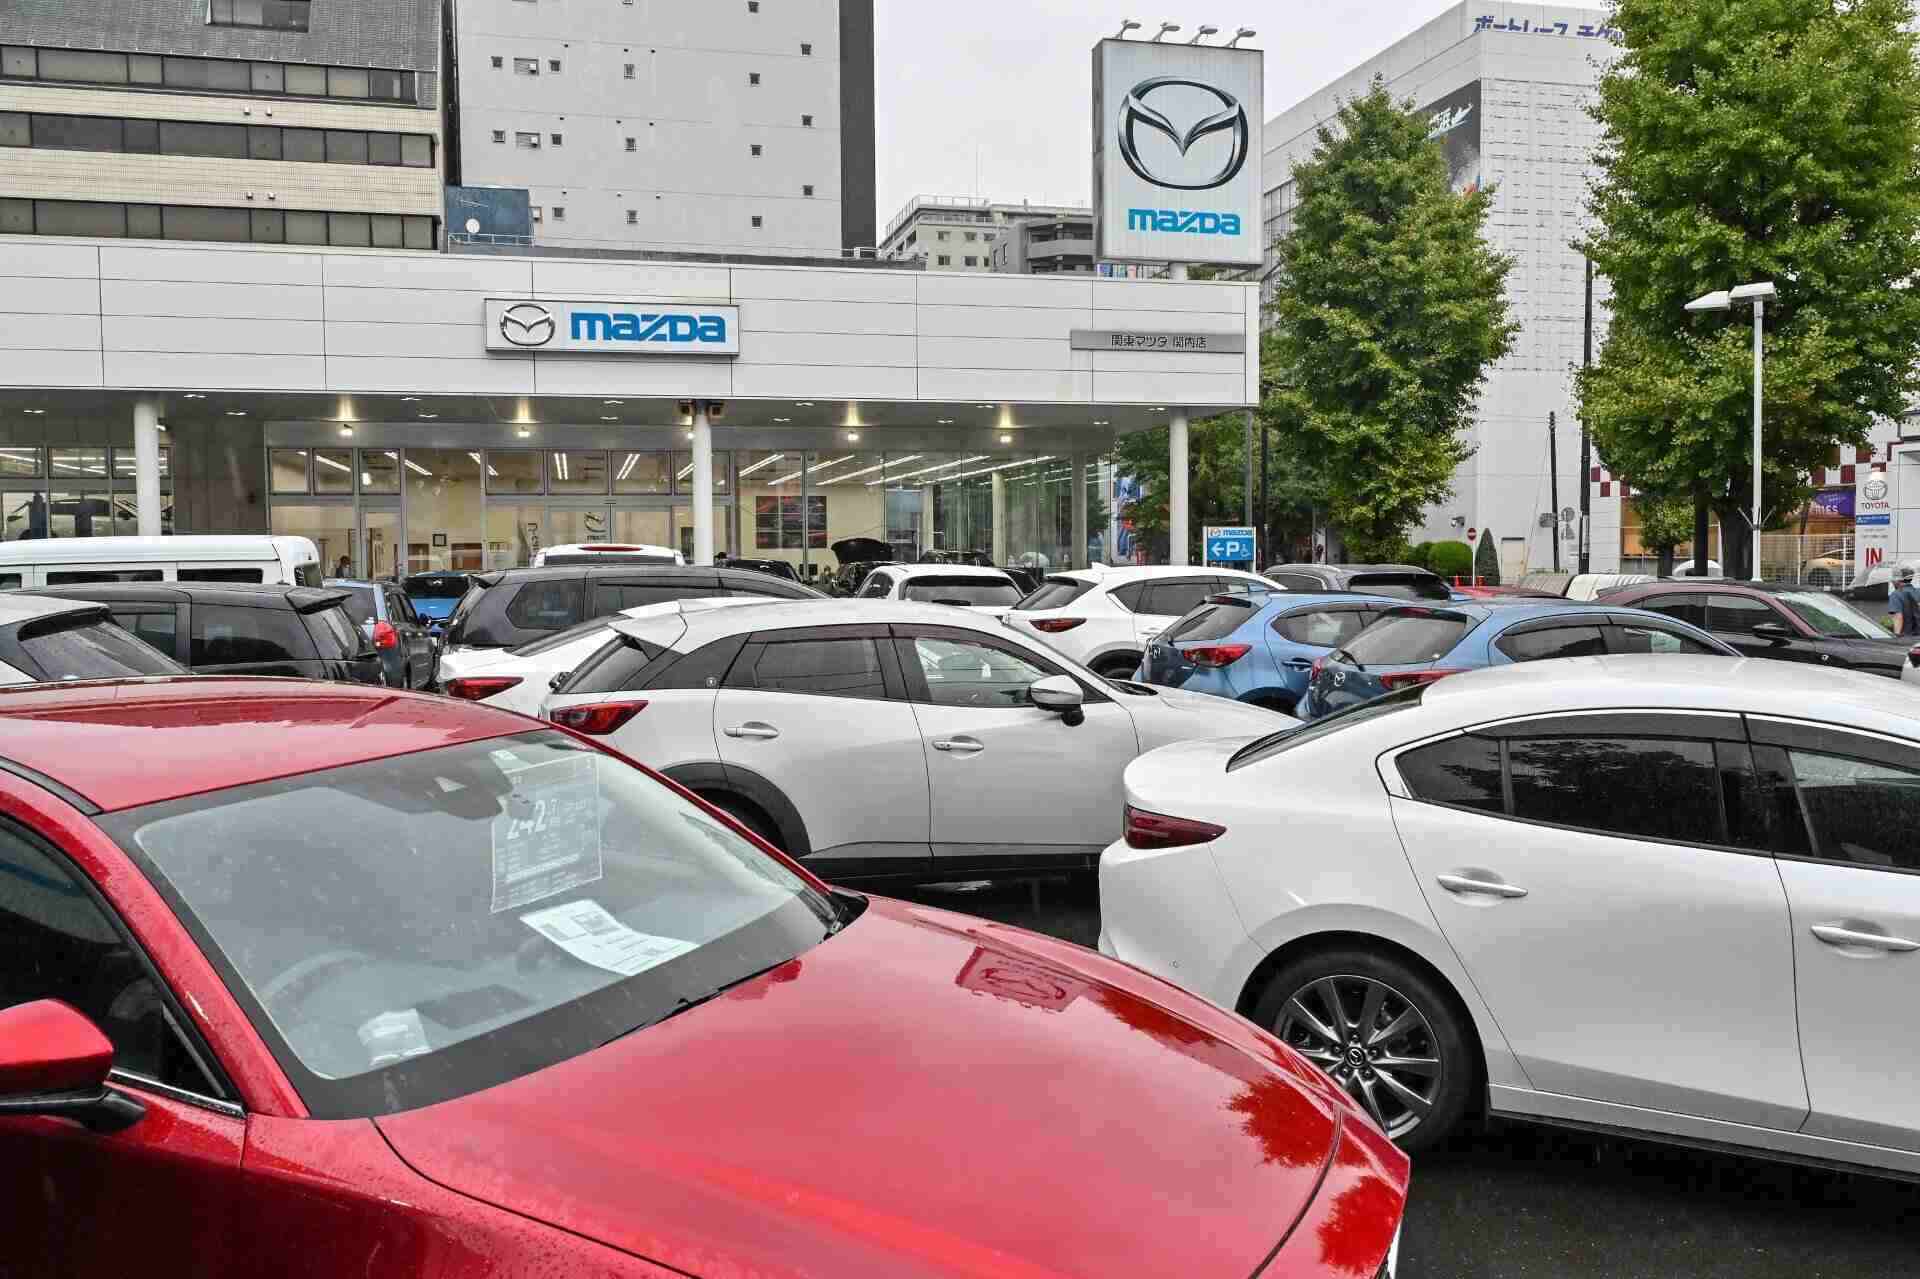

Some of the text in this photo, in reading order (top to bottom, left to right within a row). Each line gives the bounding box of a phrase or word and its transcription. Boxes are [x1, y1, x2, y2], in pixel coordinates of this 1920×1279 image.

[1860, 502, 1890, 510] TOYOTA
[1226, 541, 1240, 557] P
[1865, 547, 1883, 568] IN
